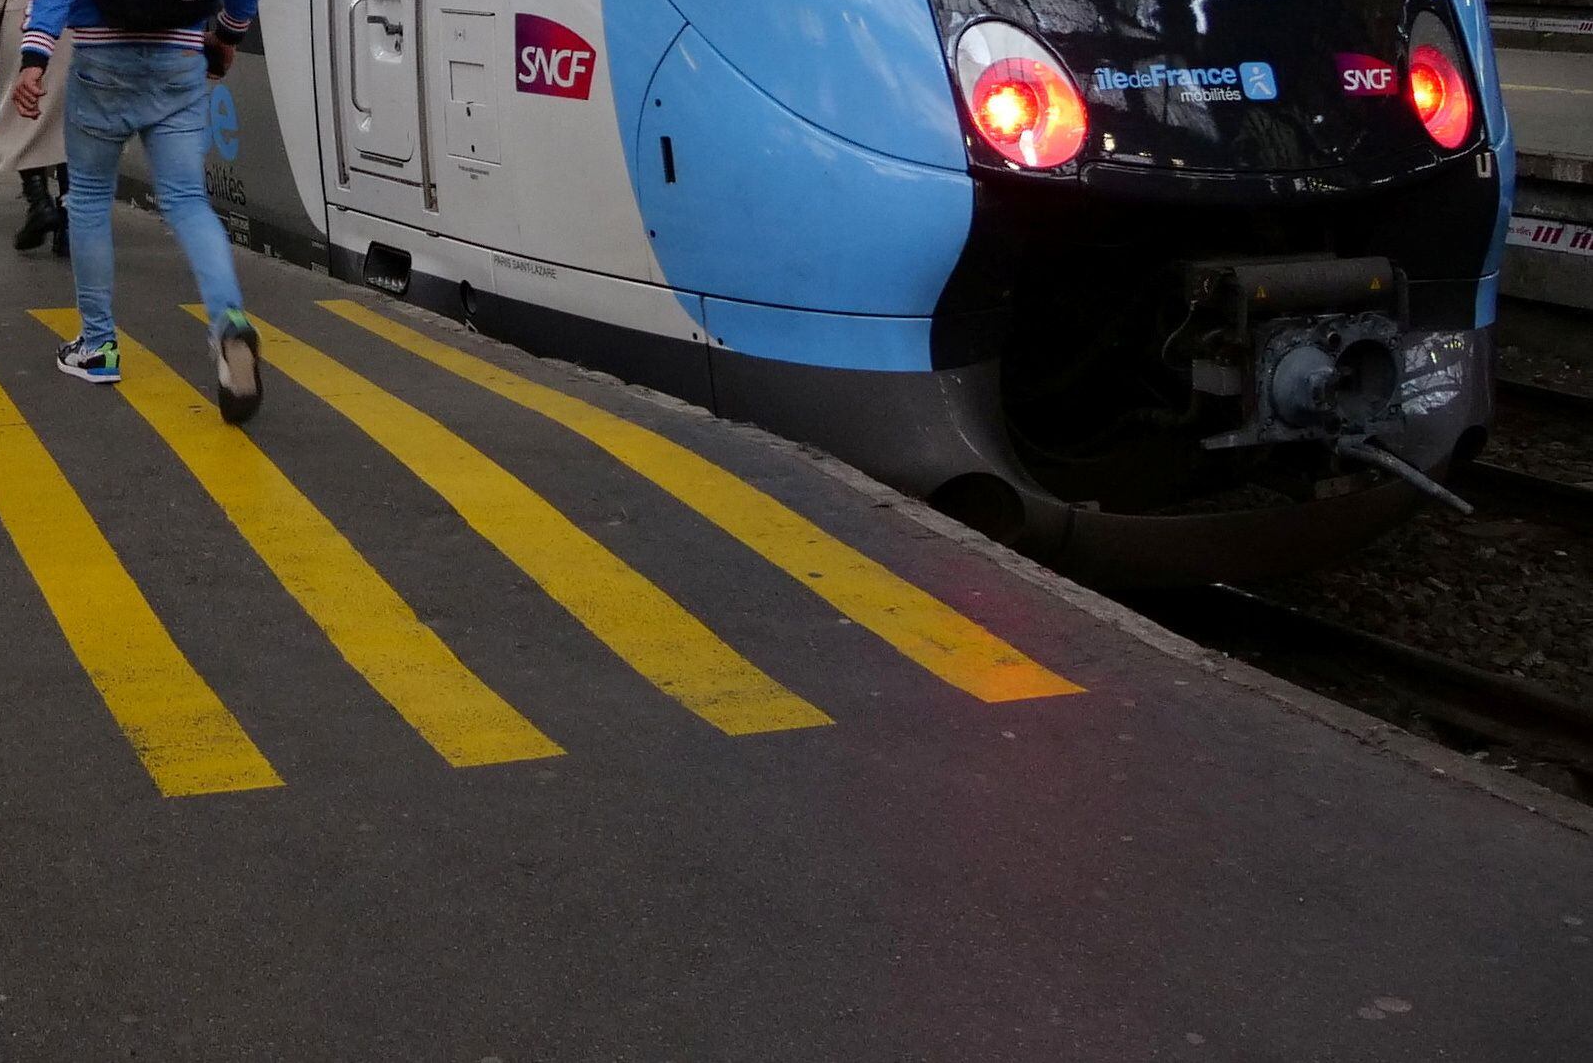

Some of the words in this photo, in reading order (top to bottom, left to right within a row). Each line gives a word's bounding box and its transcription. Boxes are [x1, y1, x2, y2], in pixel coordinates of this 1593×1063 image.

[518, 46, 590, 88] SNCF
[1343, 68, 1392, 91] SNCF
[1180, 87, 1242, 103] mobilités
